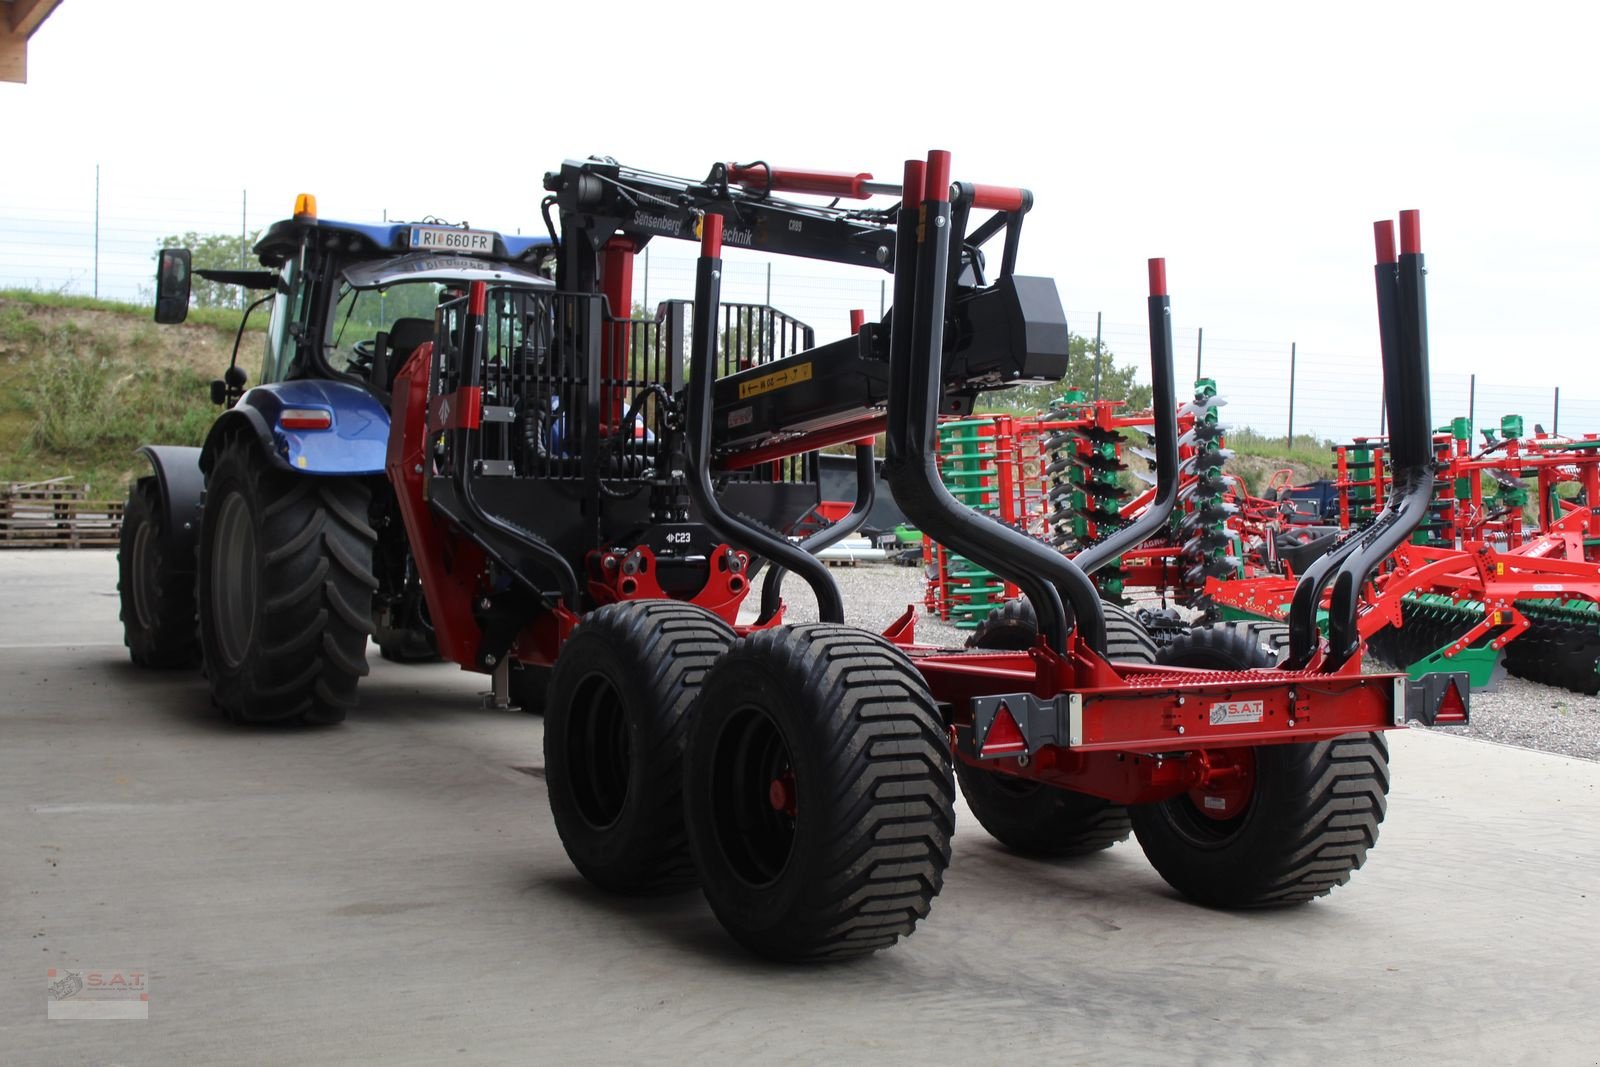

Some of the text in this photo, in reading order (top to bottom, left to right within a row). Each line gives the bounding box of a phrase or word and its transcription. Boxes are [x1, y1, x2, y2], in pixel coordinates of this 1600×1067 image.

[633, 209, 753, 246] Sensenberg echnik
[423, 231, 488, 249] RI 660 FR
[674, 532, 691, 543] C23
